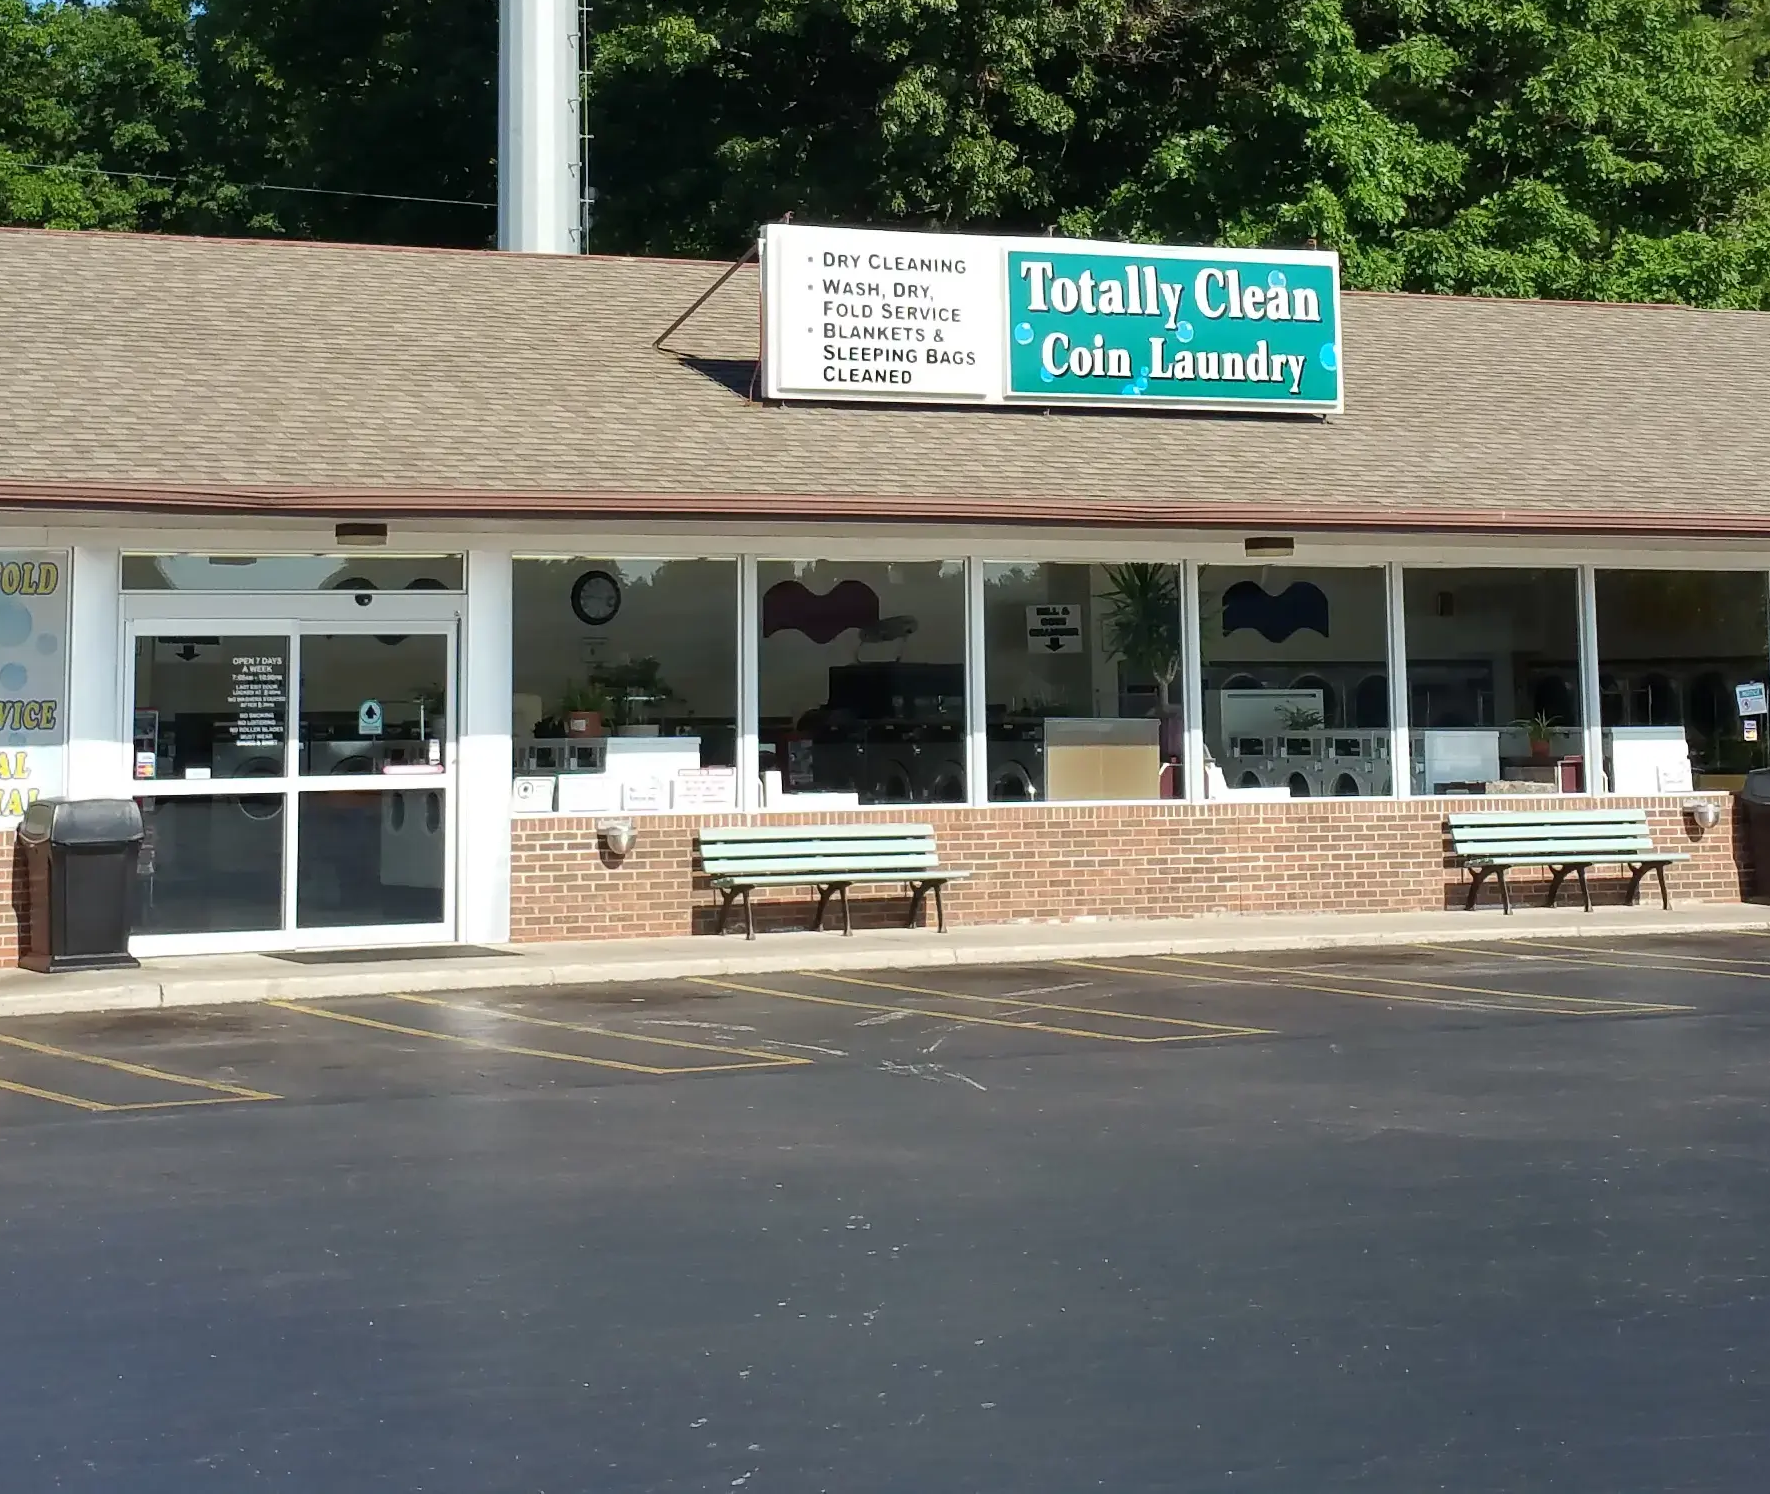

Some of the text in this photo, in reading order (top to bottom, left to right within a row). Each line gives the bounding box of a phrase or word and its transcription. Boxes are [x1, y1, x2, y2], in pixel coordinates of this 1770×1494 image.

[823, 252, 966, 274] DRY CLEANING
[823, 279, 934, 301] WASH, DRY,
[1021, 261, 1322, 331] Totally Clean
[823, 301, 962, 322] FOLD SERVICE
[823, 323, 944, 342] BLANKETS &
[823, 345, 976, 366] SLEEPING BAGS
[1042, 332, 1306, 394] Coin Laundry
[823, 366, 912, 384] CLEANED
[232, 657, 254, 665] OPEN
[261, 657, 283, 665] DAYS
[242, 665, 249, 673] A
